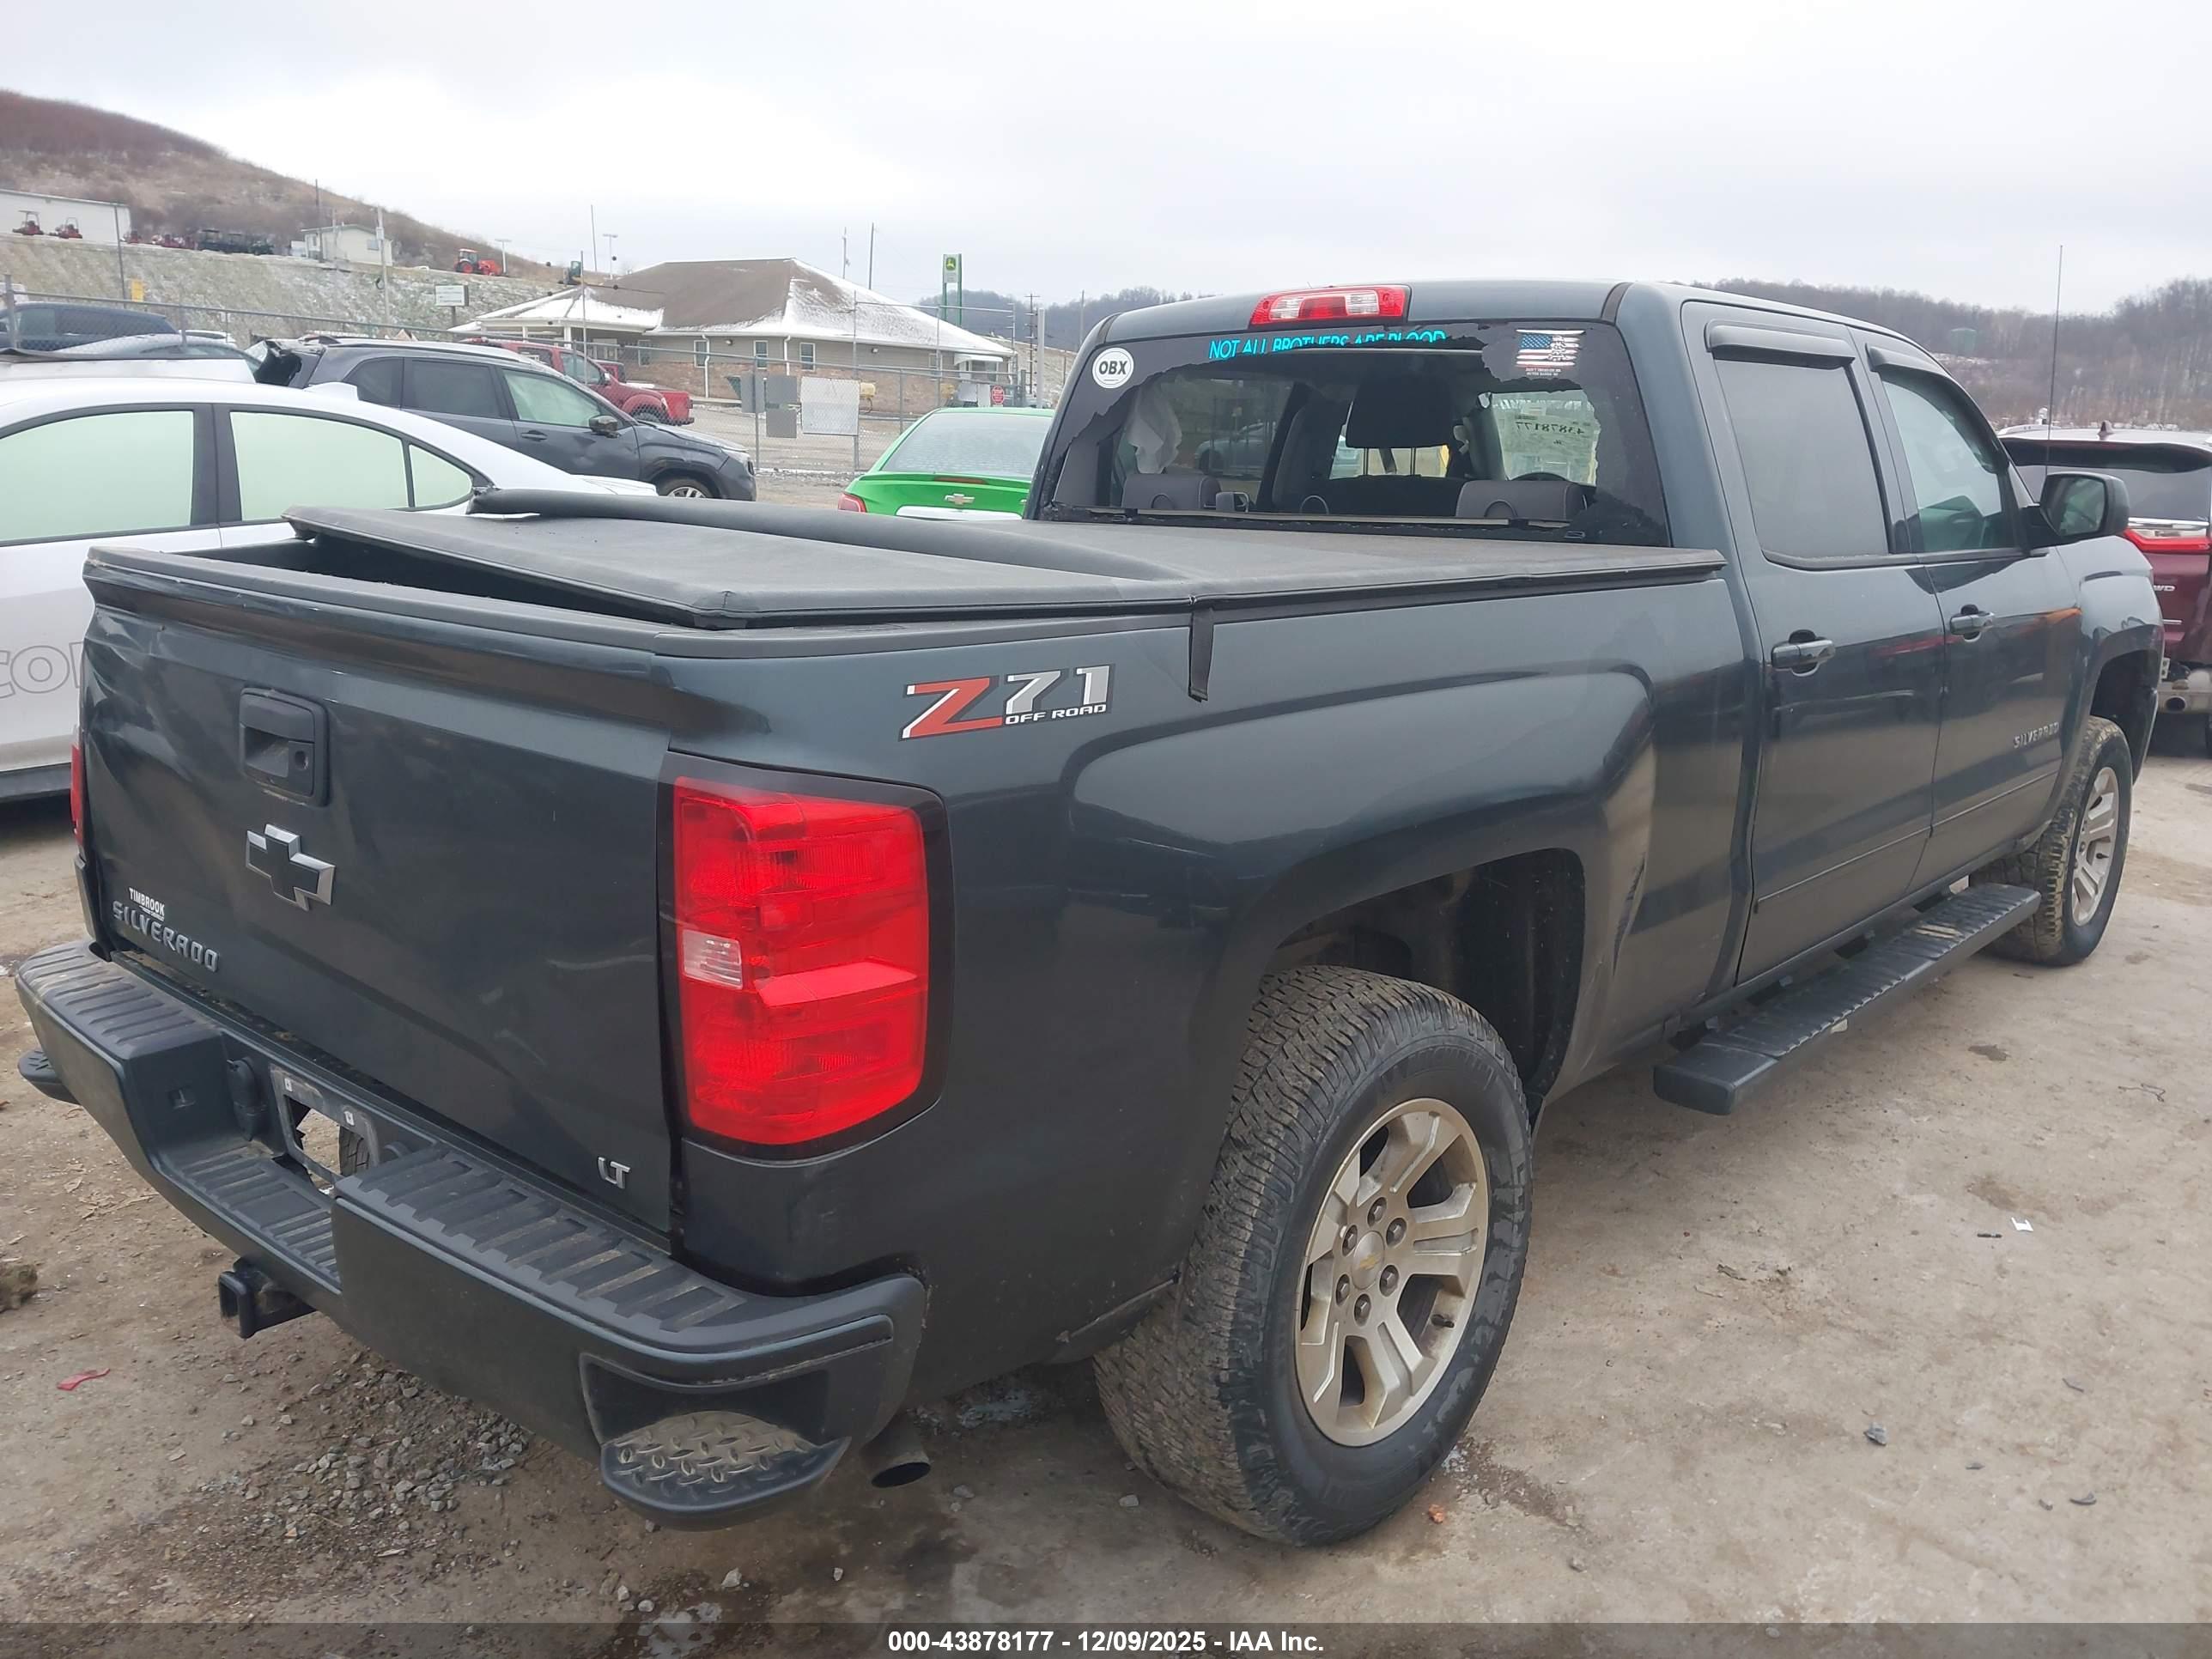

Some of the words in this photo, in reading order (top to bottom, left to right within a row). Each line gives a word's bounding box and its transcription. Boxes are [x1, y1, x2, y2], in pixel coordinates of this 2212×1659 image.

[1208, 339, 1241, 359] NOT
[1099, 361, 1127, 374] OBX
[900, 664, 1111, 739] Z71
[1006, 711, 1046, 726] OFF
[1051, 703, 1108, 719] ROAD
[129, 886, 165, 916] TIMBROOK
[112, 900, 218, 973] SILVERADO
[598, 1156, 631, 1189] LT
